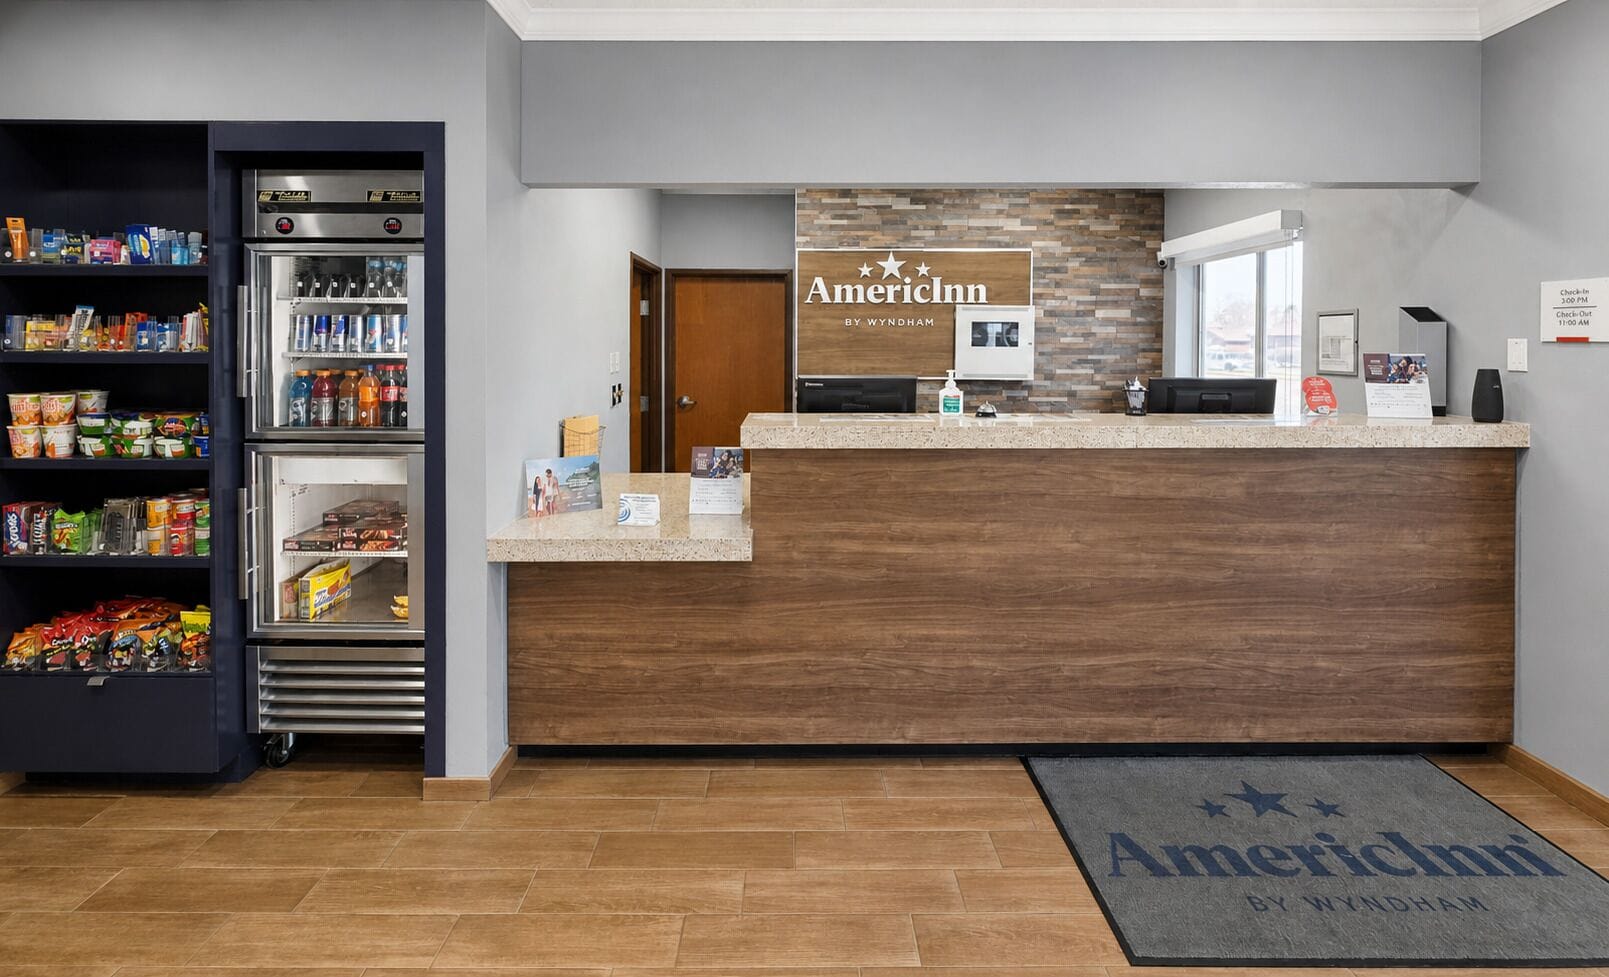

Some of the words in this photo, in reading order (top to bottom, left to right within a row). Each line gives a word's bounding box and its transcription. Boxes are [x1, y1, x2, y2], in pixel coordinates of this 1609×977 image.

[804, 276, 988, 304] AmericInn
[1556, 310, 1592, 318] Check-Out
[845, 318, 861, 326] BY
[868, 318, 934, 326] WYNDHAM
[1248, 896, 1287, 912] BY
[1303, 896, 1489, 912] WYNDHAM
